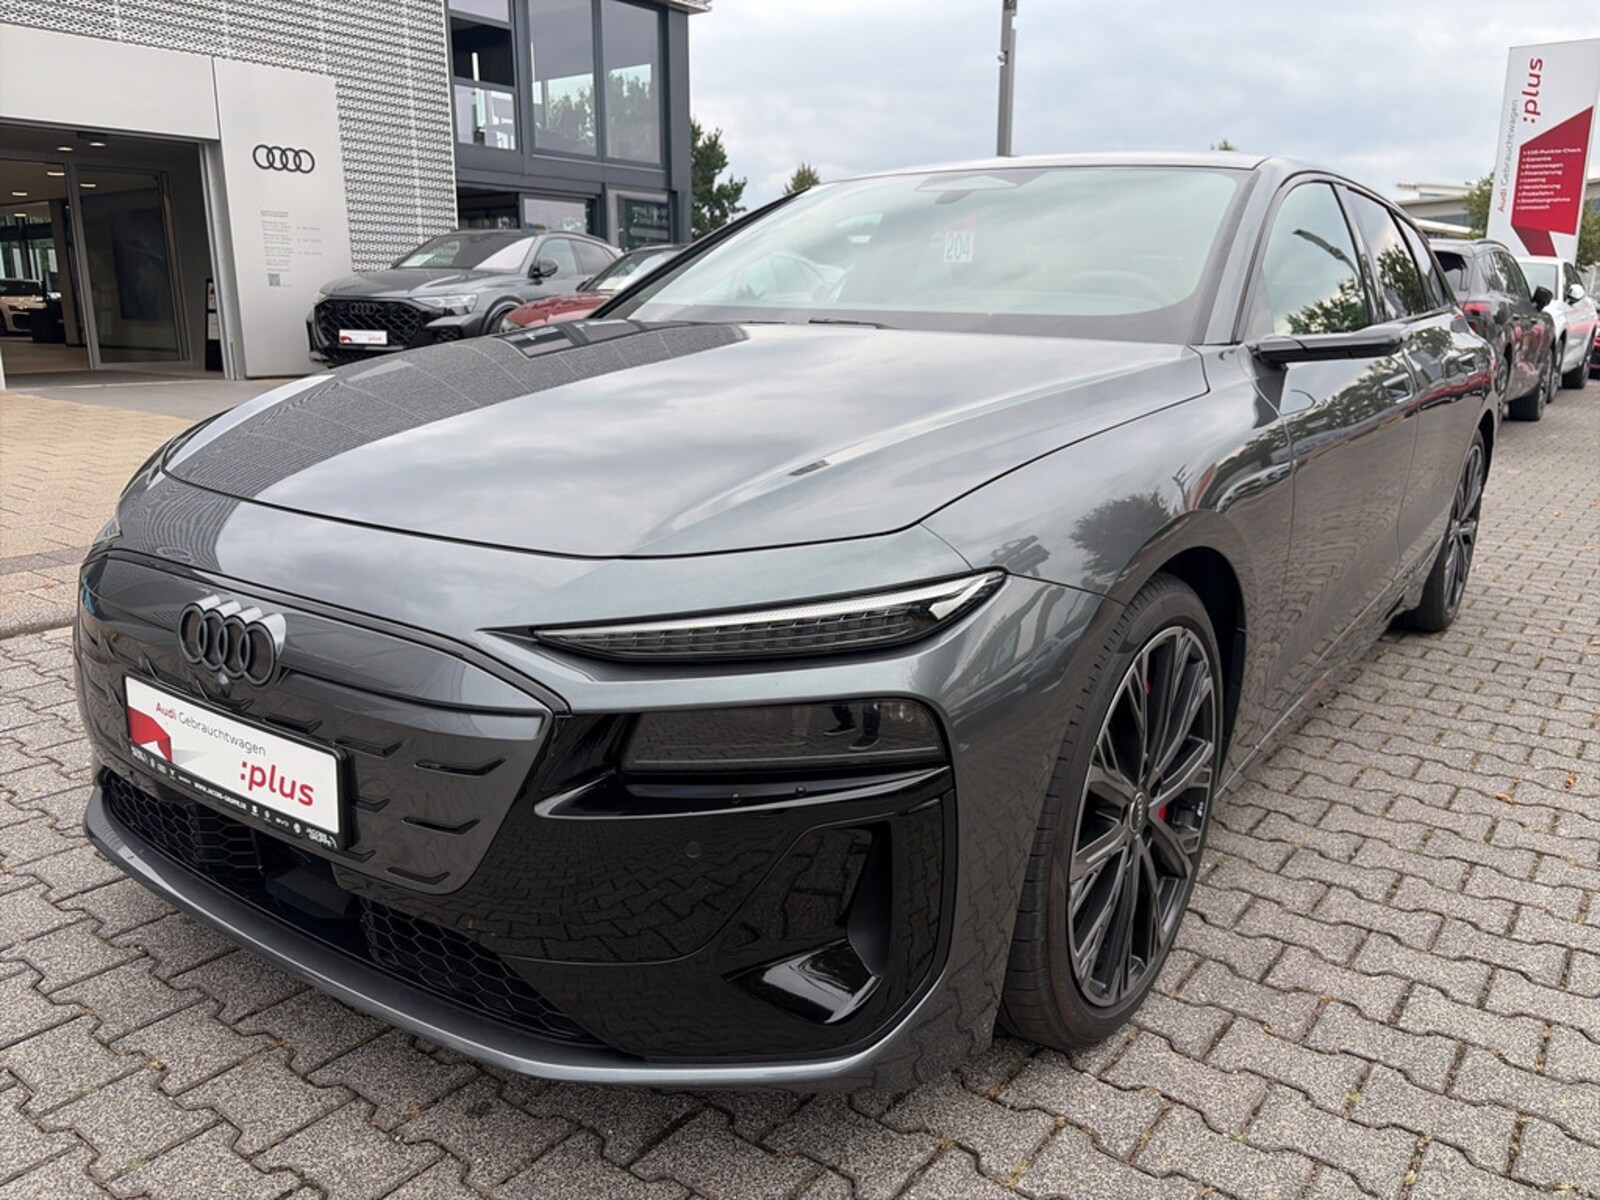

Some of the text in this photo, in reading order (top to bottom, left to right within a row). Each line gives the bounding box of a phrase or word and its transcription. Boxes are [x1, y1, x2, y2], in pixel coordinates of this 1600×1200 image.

[1521, 58, 1543, 123] :plus
[1497, 99, 1519, 212] Audi Gebrauchtwagen
[946, 234, 970, 260] 204
[156, 702, 177, 720] Audi
[178, 712, 266, 757] Gebrauchtwagen
[240, 761, 314, 806] :plus
